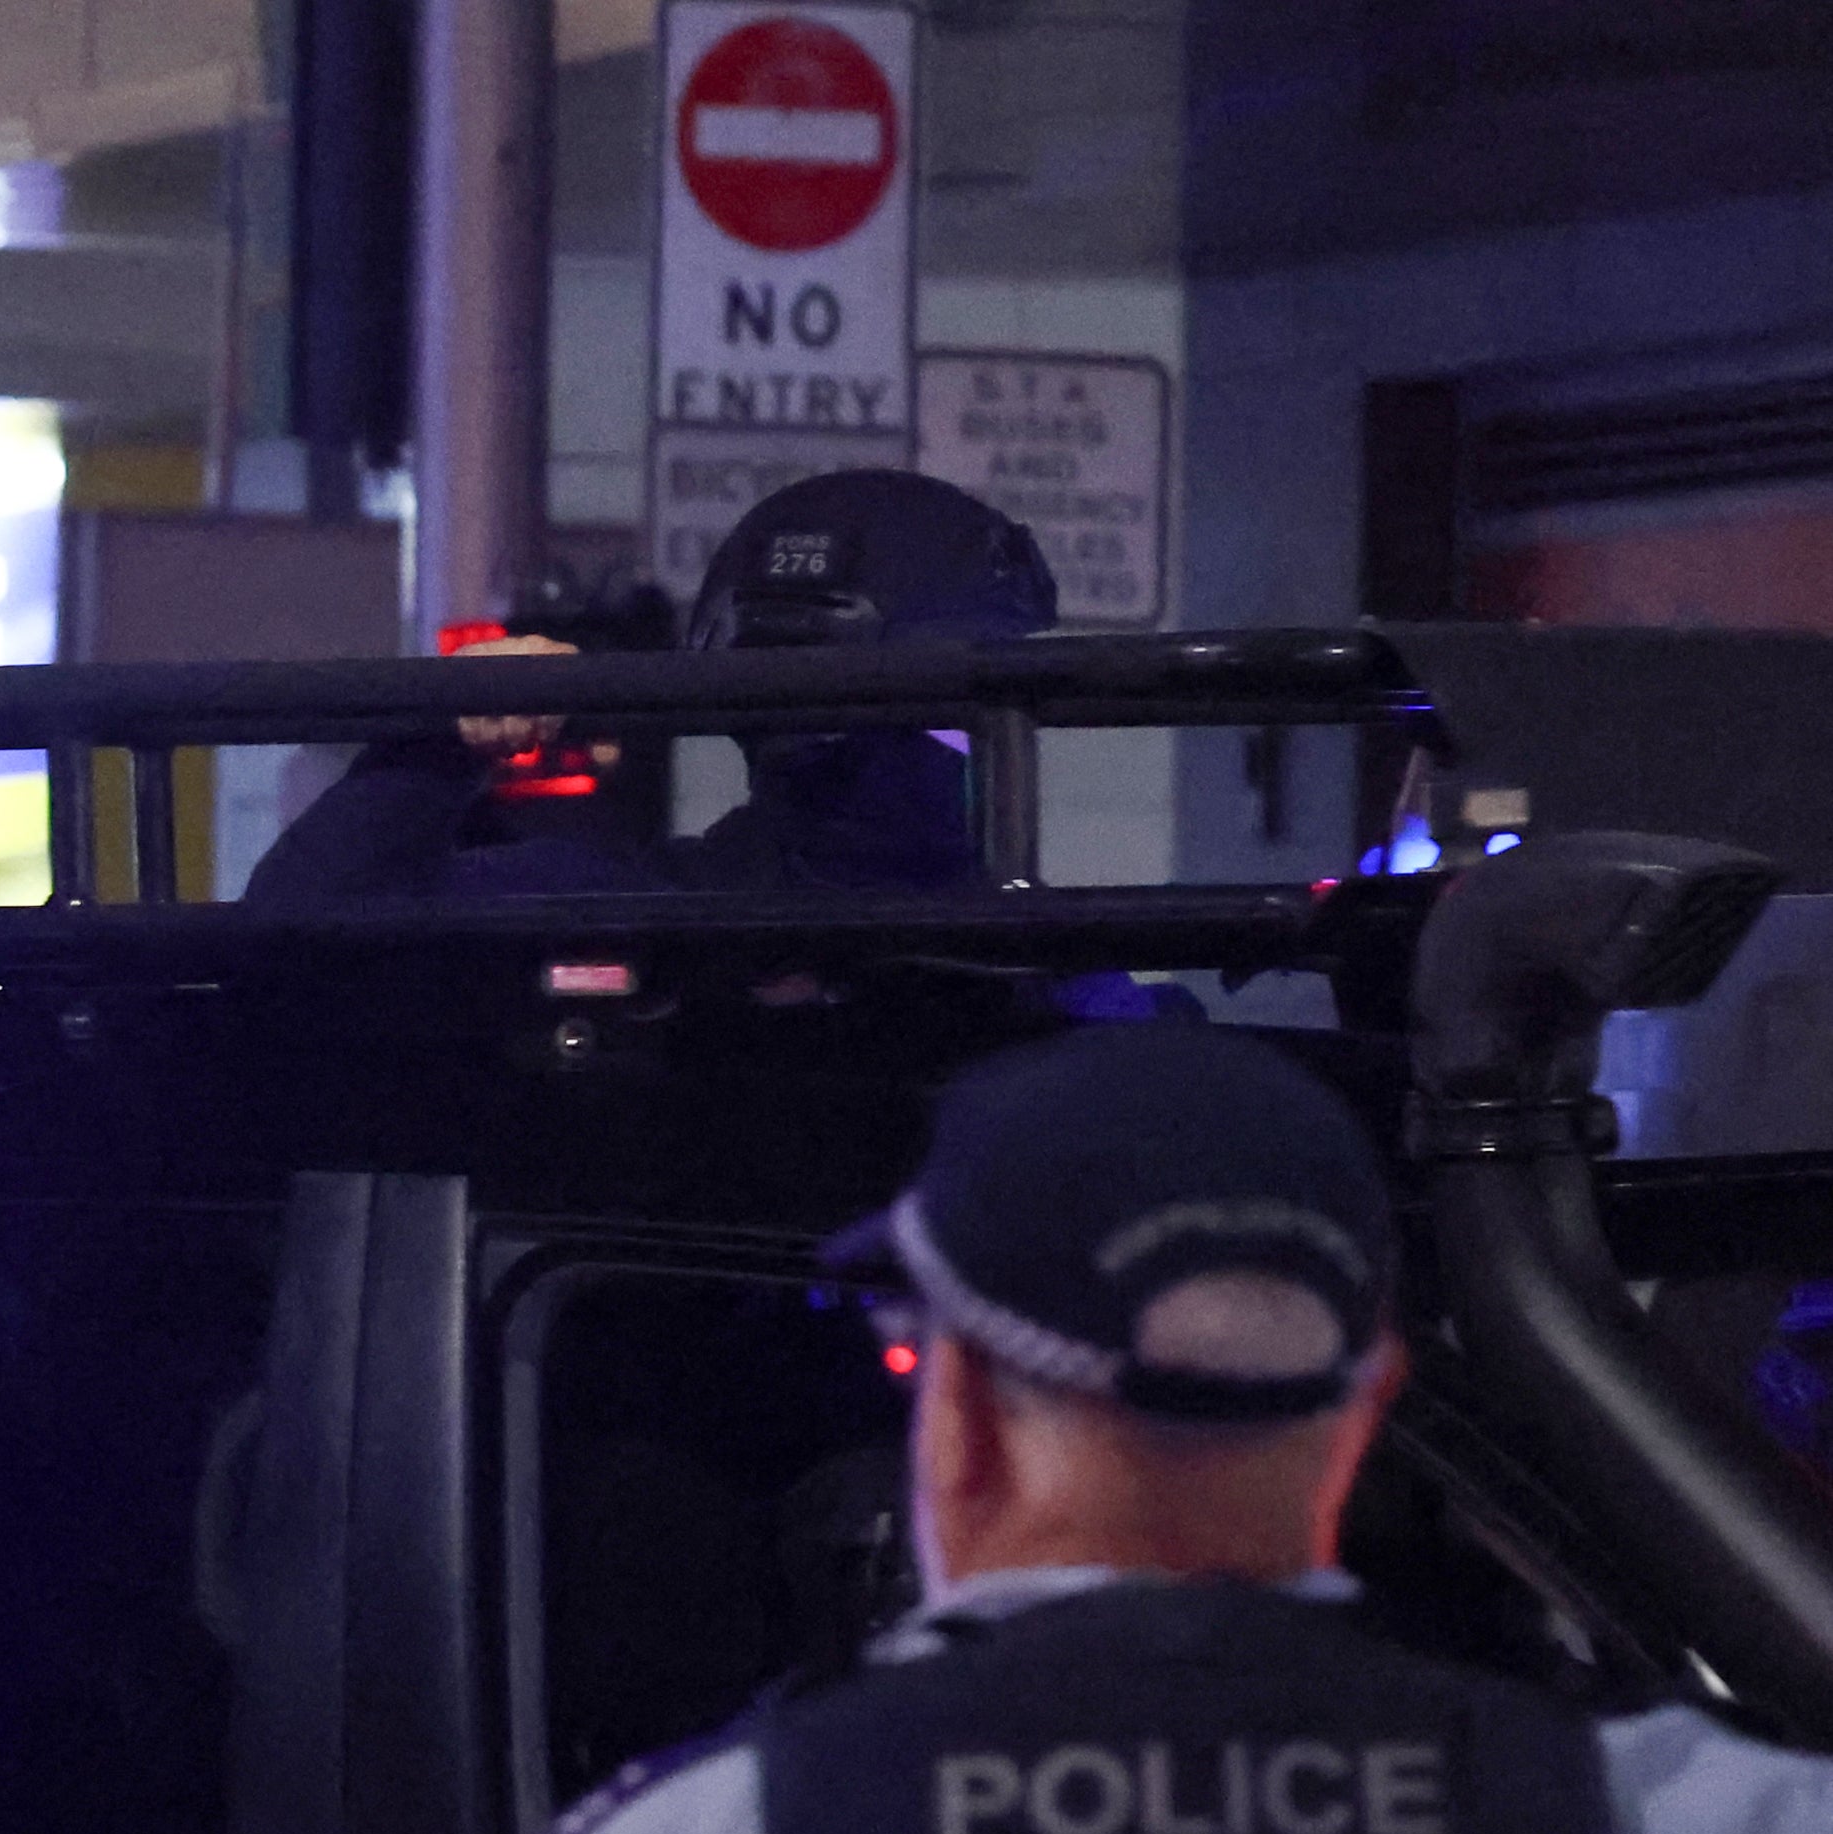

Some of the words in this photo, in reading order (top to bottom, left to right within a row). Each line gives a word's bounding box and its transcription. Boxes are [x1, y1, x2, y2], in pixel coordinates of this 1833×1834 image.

[723, 281, 842, 348] NO
[673, 370, 895, 426] ENTRY
[768, 552, 828, 575] 276
